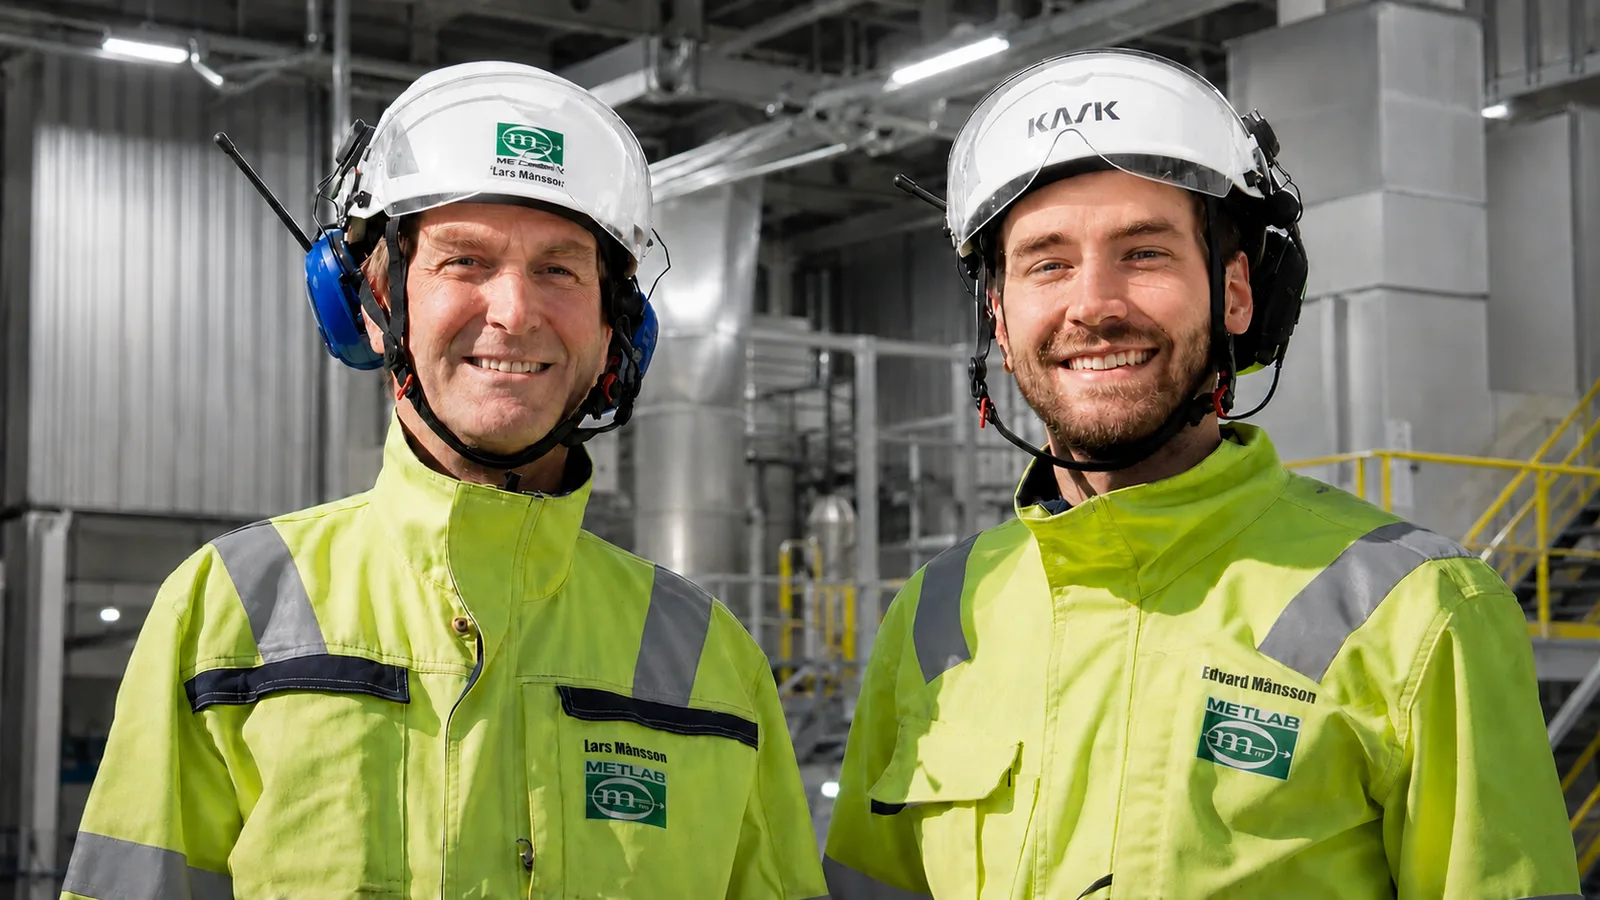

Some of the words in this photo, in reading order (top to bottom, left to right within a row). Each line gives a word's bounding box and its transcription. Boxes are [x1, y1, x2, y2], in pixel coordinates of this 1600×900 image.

[1028, 101, 1121, 139] KASK
[1201, 666, 1249, 690] Edvard
[1251, 676, 1317, 704] Månsson
[1207, 697, 1300, 730] METLAB
[584, 739, 612, 753] Lars
[614, 741, 667, 763] Månsson
[586, 761, 666, 783] METLAB
